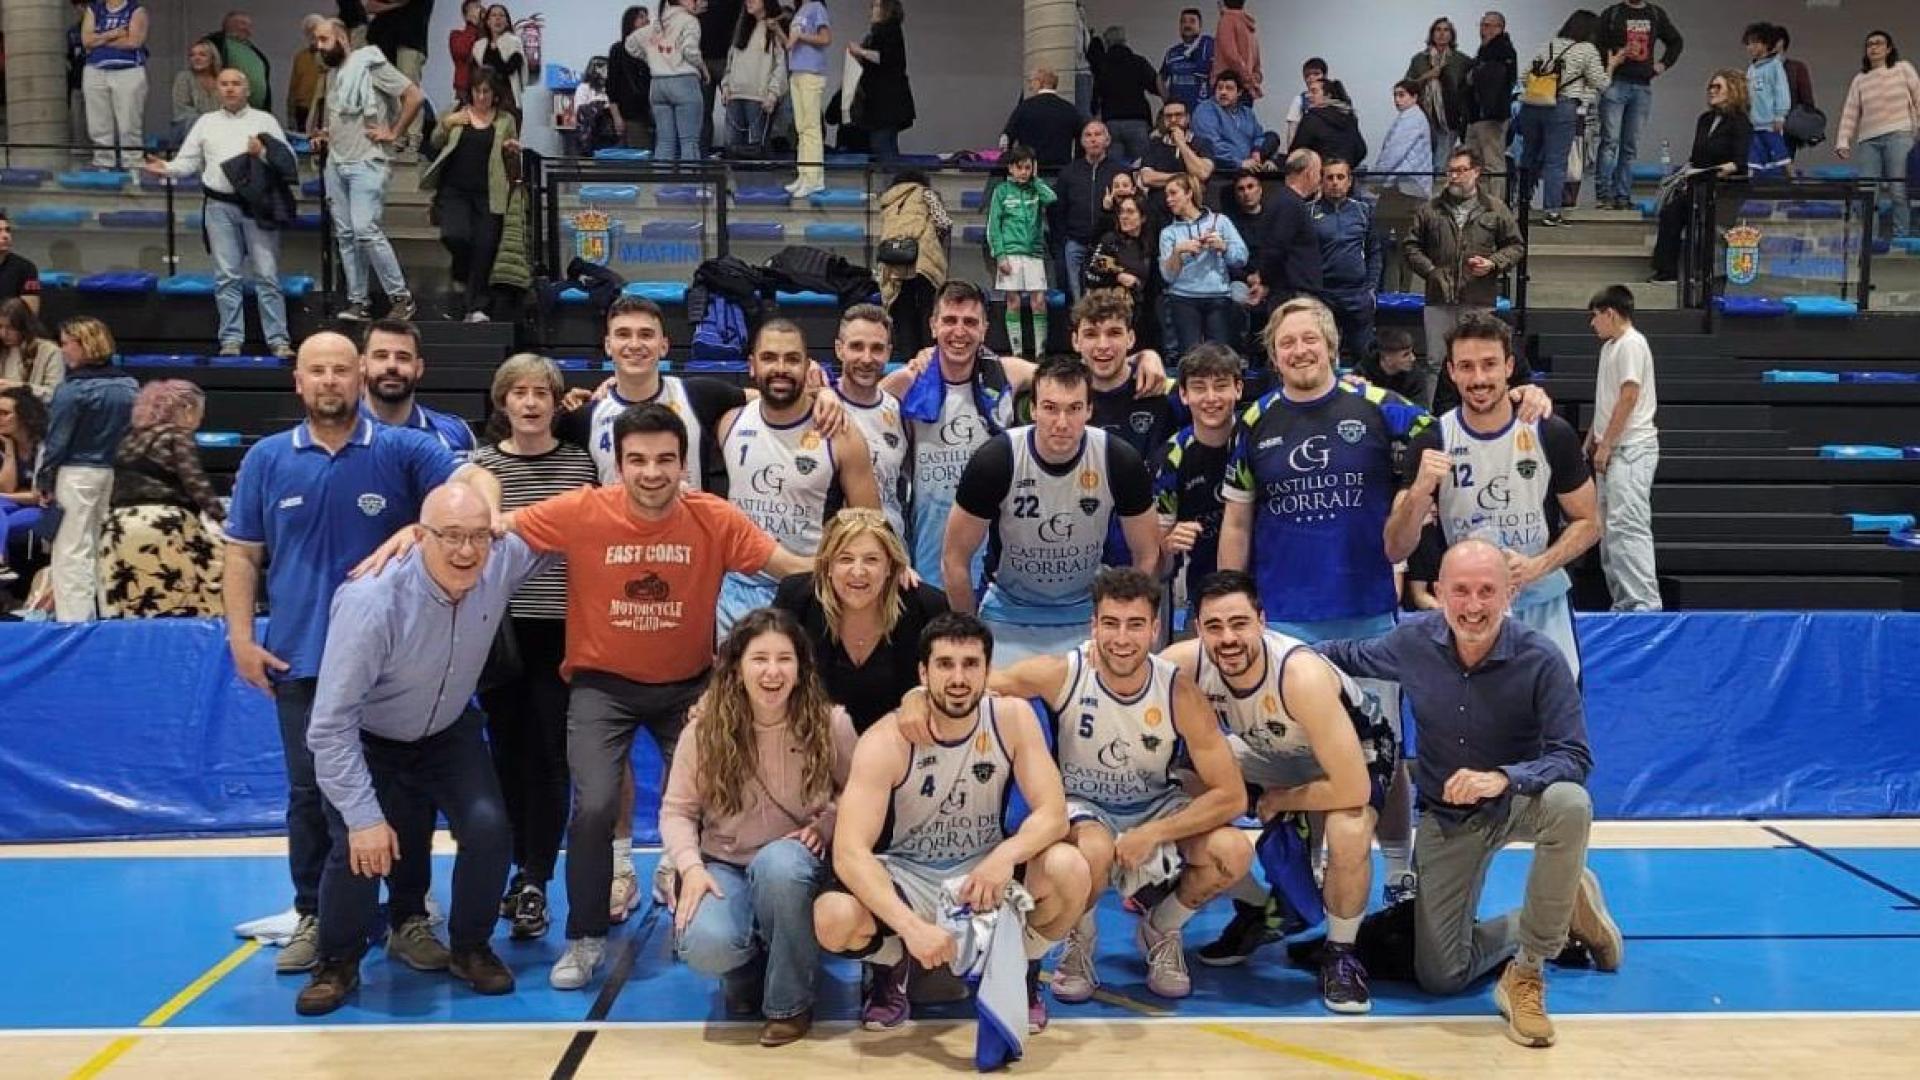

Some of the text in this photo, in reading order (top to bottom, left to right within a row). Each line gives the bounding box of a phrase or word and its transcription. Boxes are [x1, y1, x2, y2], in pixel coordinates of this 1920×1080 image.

[600, 432, 612, 453] 4
[739, 444, 748, 466] 1
[919, 449, 969, 463] CASTILL
[920, 465, 964, 482] GOR
[1266, 472, 1364, 494] CASTILLO DE
[1450, 462, 1474, 488] 12
[1014, 495, 1039, 518] 22
[1269, 489, 1363, 515] GORRAIZ
[605, 543, 692, 565] EAST COAST
[1009, 544, 1079, 559] CASTILLO
[609, 599, 683, 618] MOTORCYCLE
[633, 616, 659, 631] CLUB
[1079, 713, 1094, 739] 5
[920, 774, 936, 797] 4
